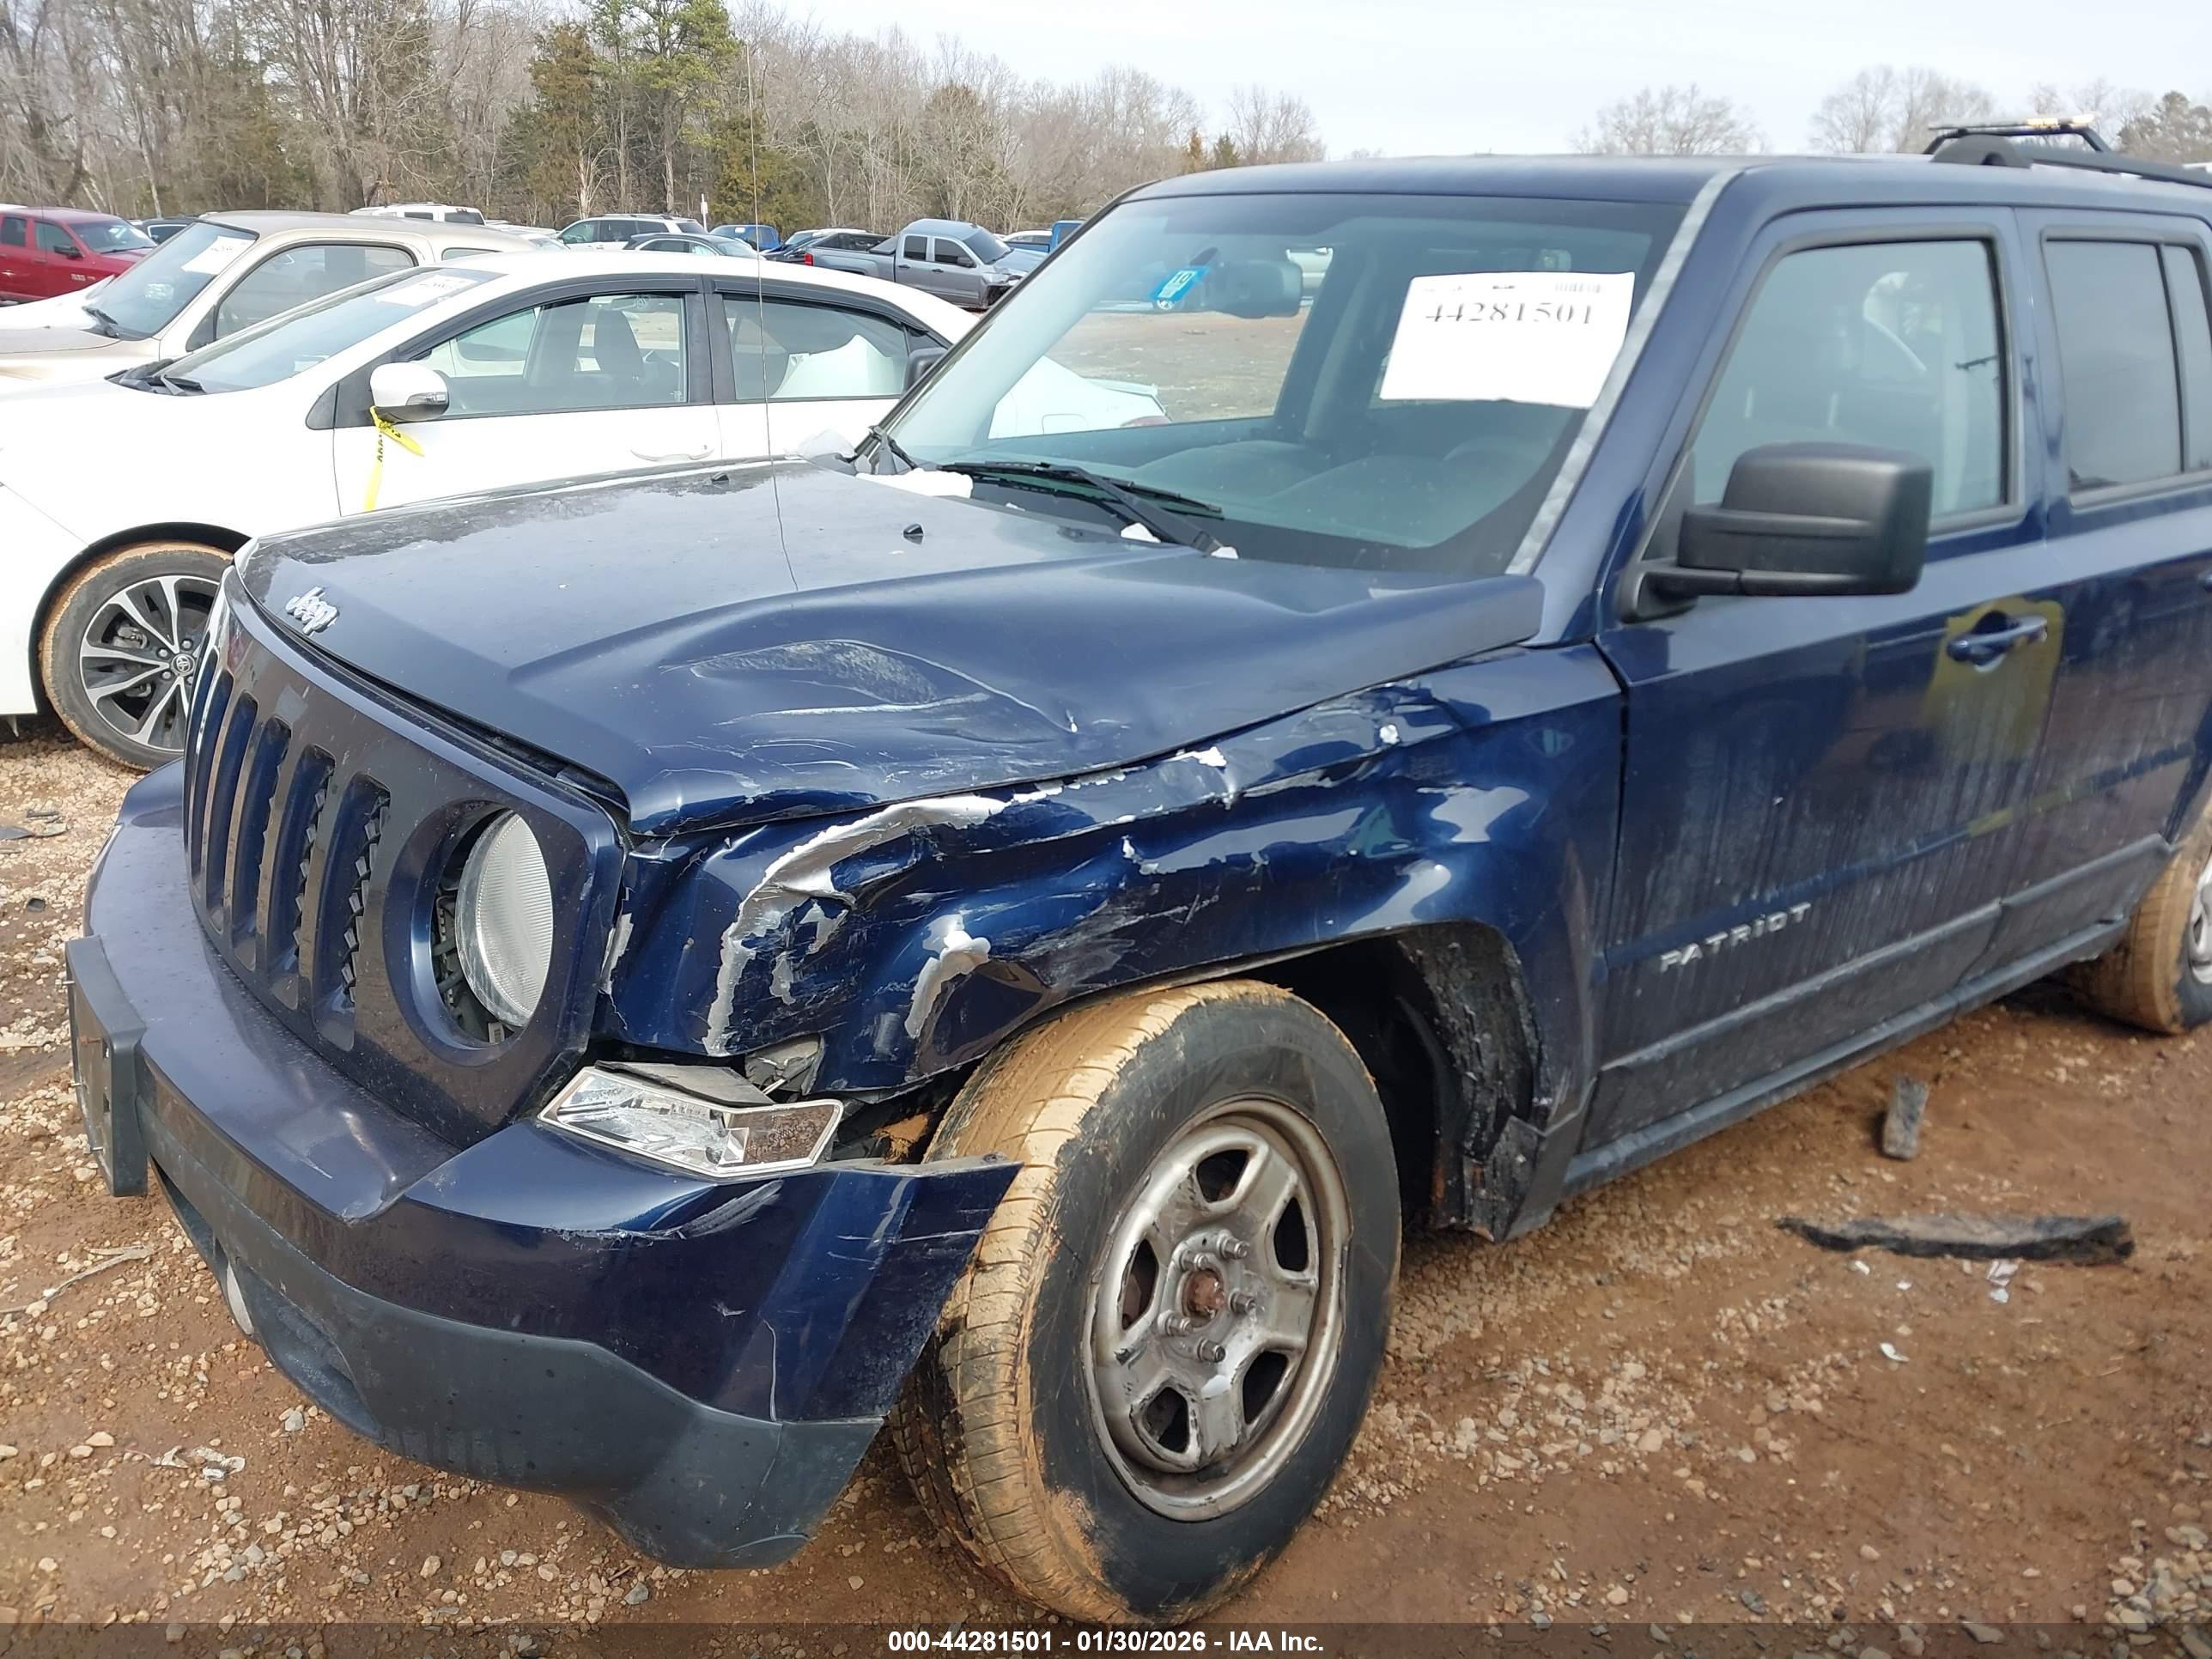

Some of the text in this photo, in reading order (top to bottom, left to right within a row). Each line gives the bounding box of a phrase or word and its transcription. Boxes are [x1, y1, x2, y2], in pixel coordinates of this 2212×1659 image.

[1425, 301, 1592, 325] 44281501
[284, 586, 337, 635] Jeep
[1660, 901, 1812, 974] PATRIOT
